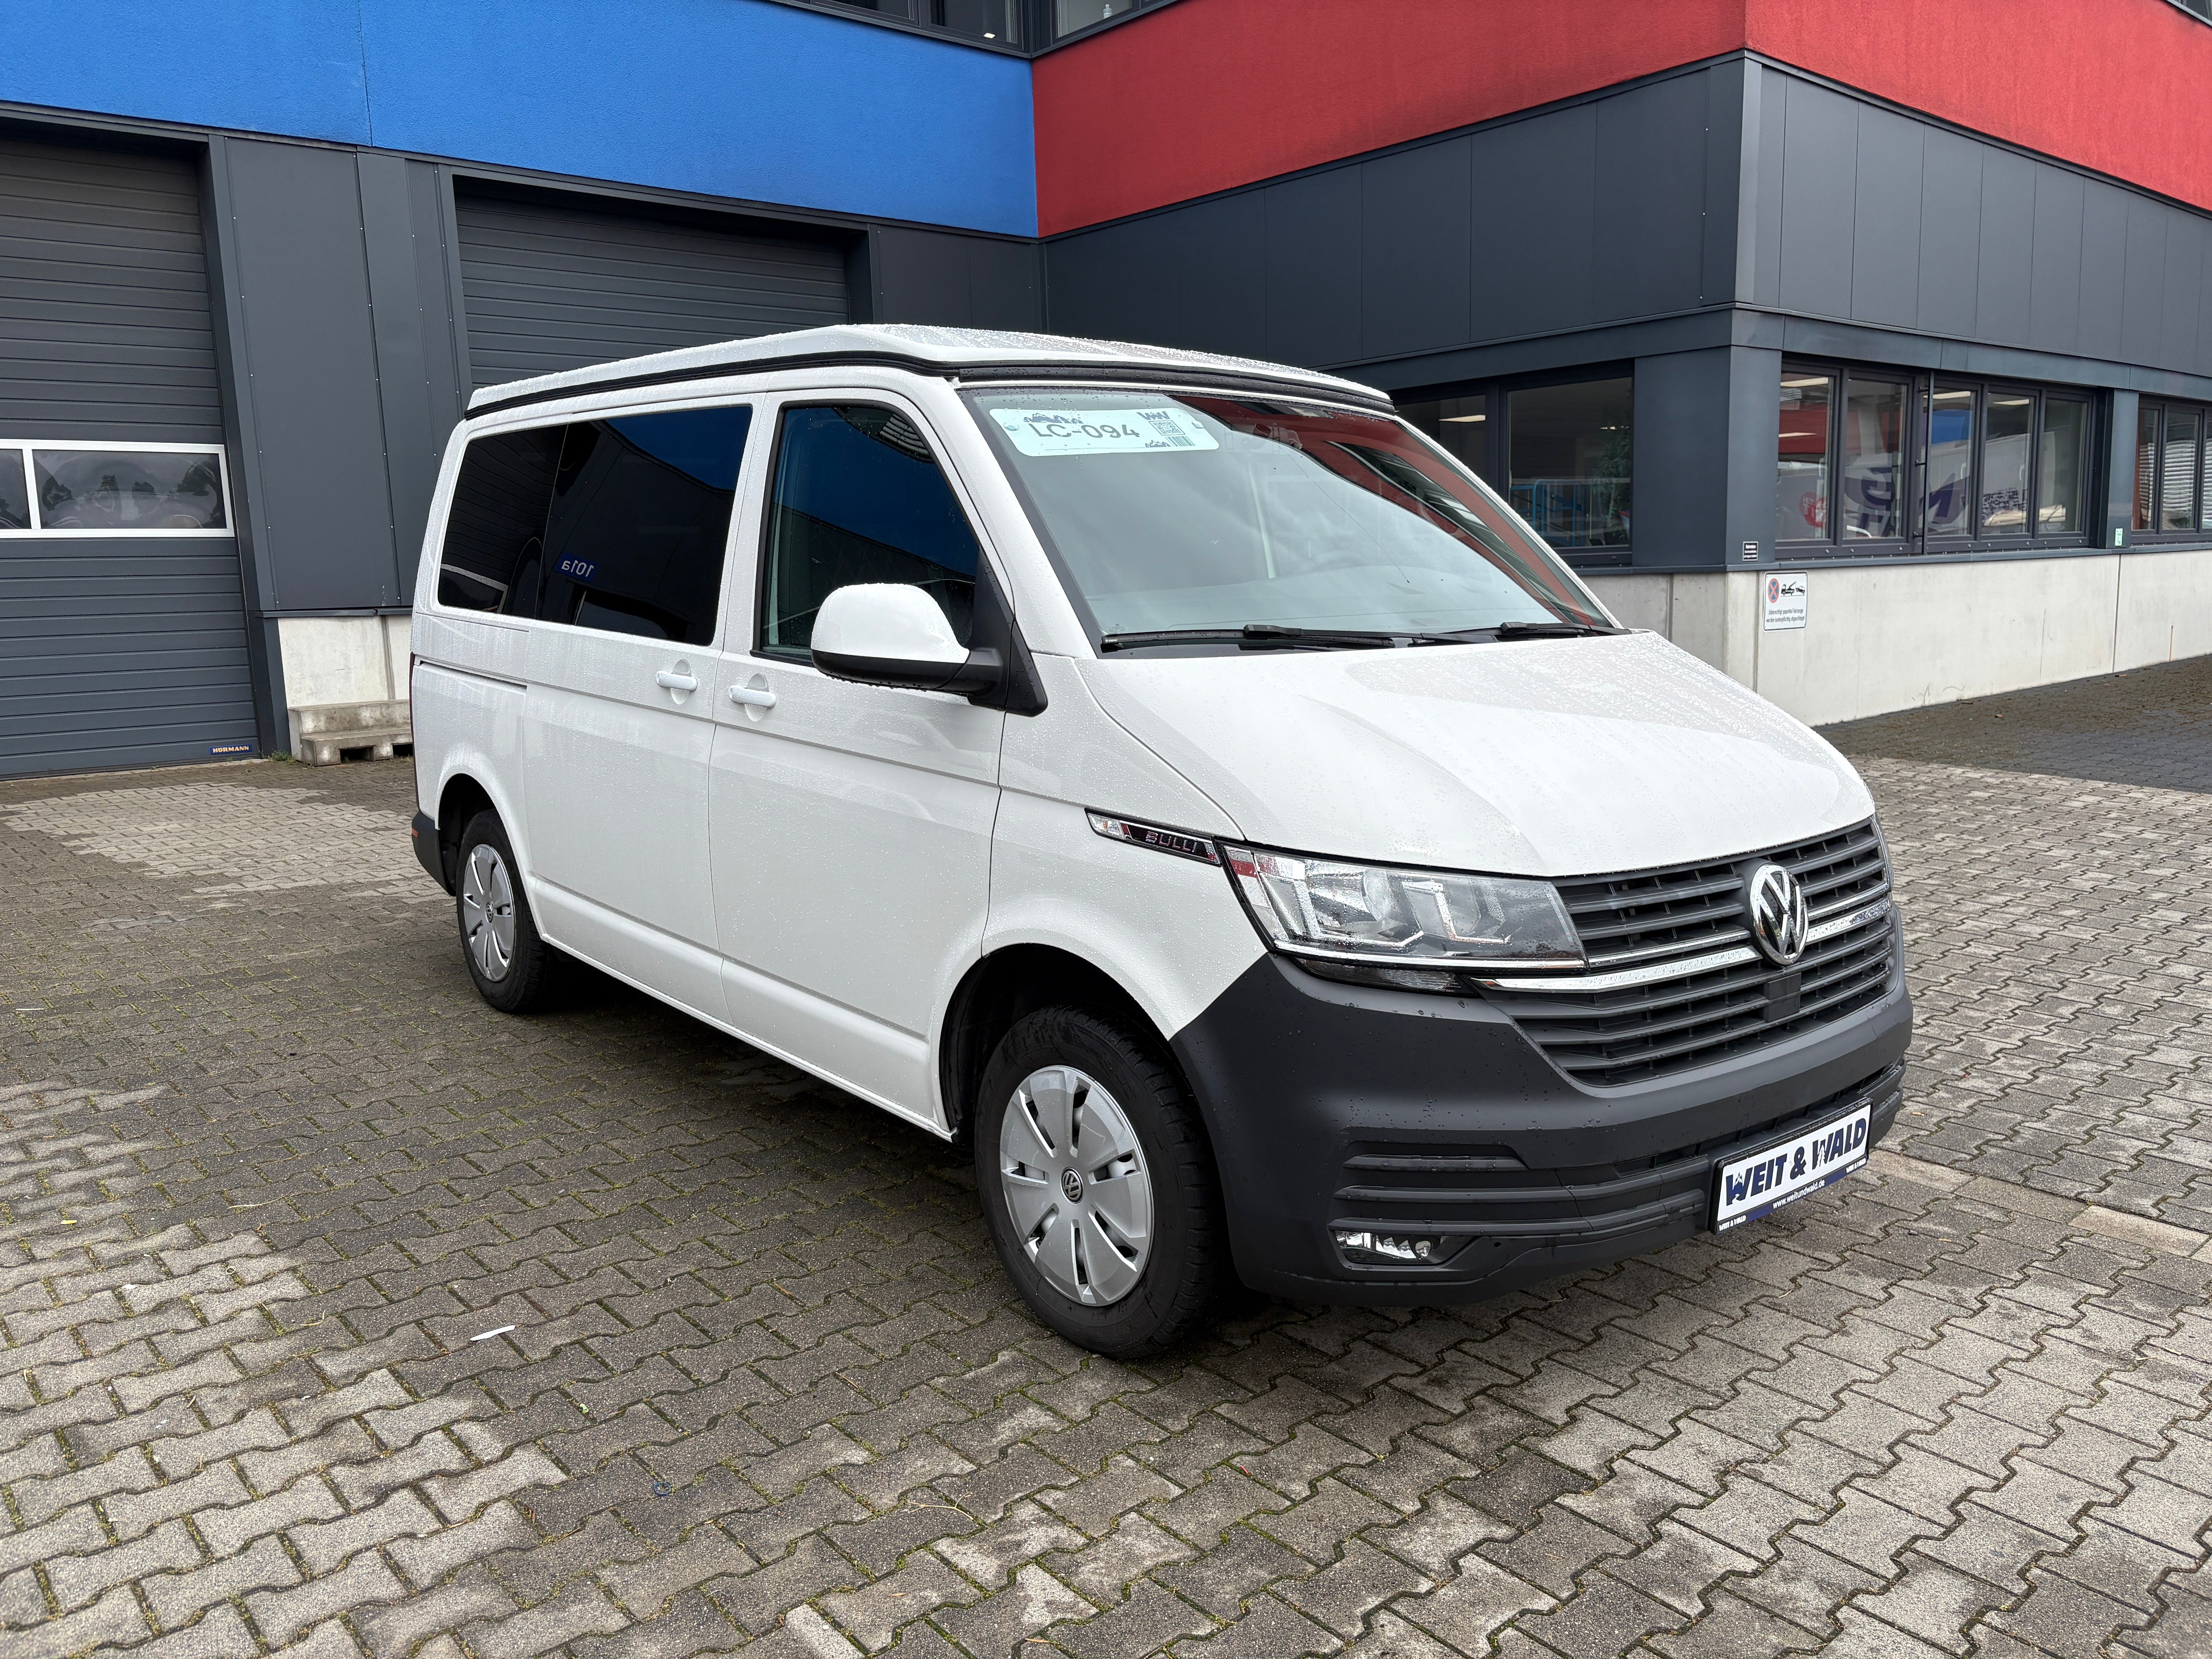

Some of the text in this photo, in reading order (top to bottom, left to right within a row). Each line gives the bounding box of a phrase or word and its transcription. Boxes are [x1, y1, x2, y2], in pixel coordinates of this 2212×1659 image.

[1028, 423, 1140, 438] LC-094
[213, 745, 249, 753] HÖRMANN
[1146, 831, 1197, 852] BULLI
[1726, 1118, 1866, 1206] WEIT & WALD
[1772, 1179, 1825, 1209] www.weitundwald.de
